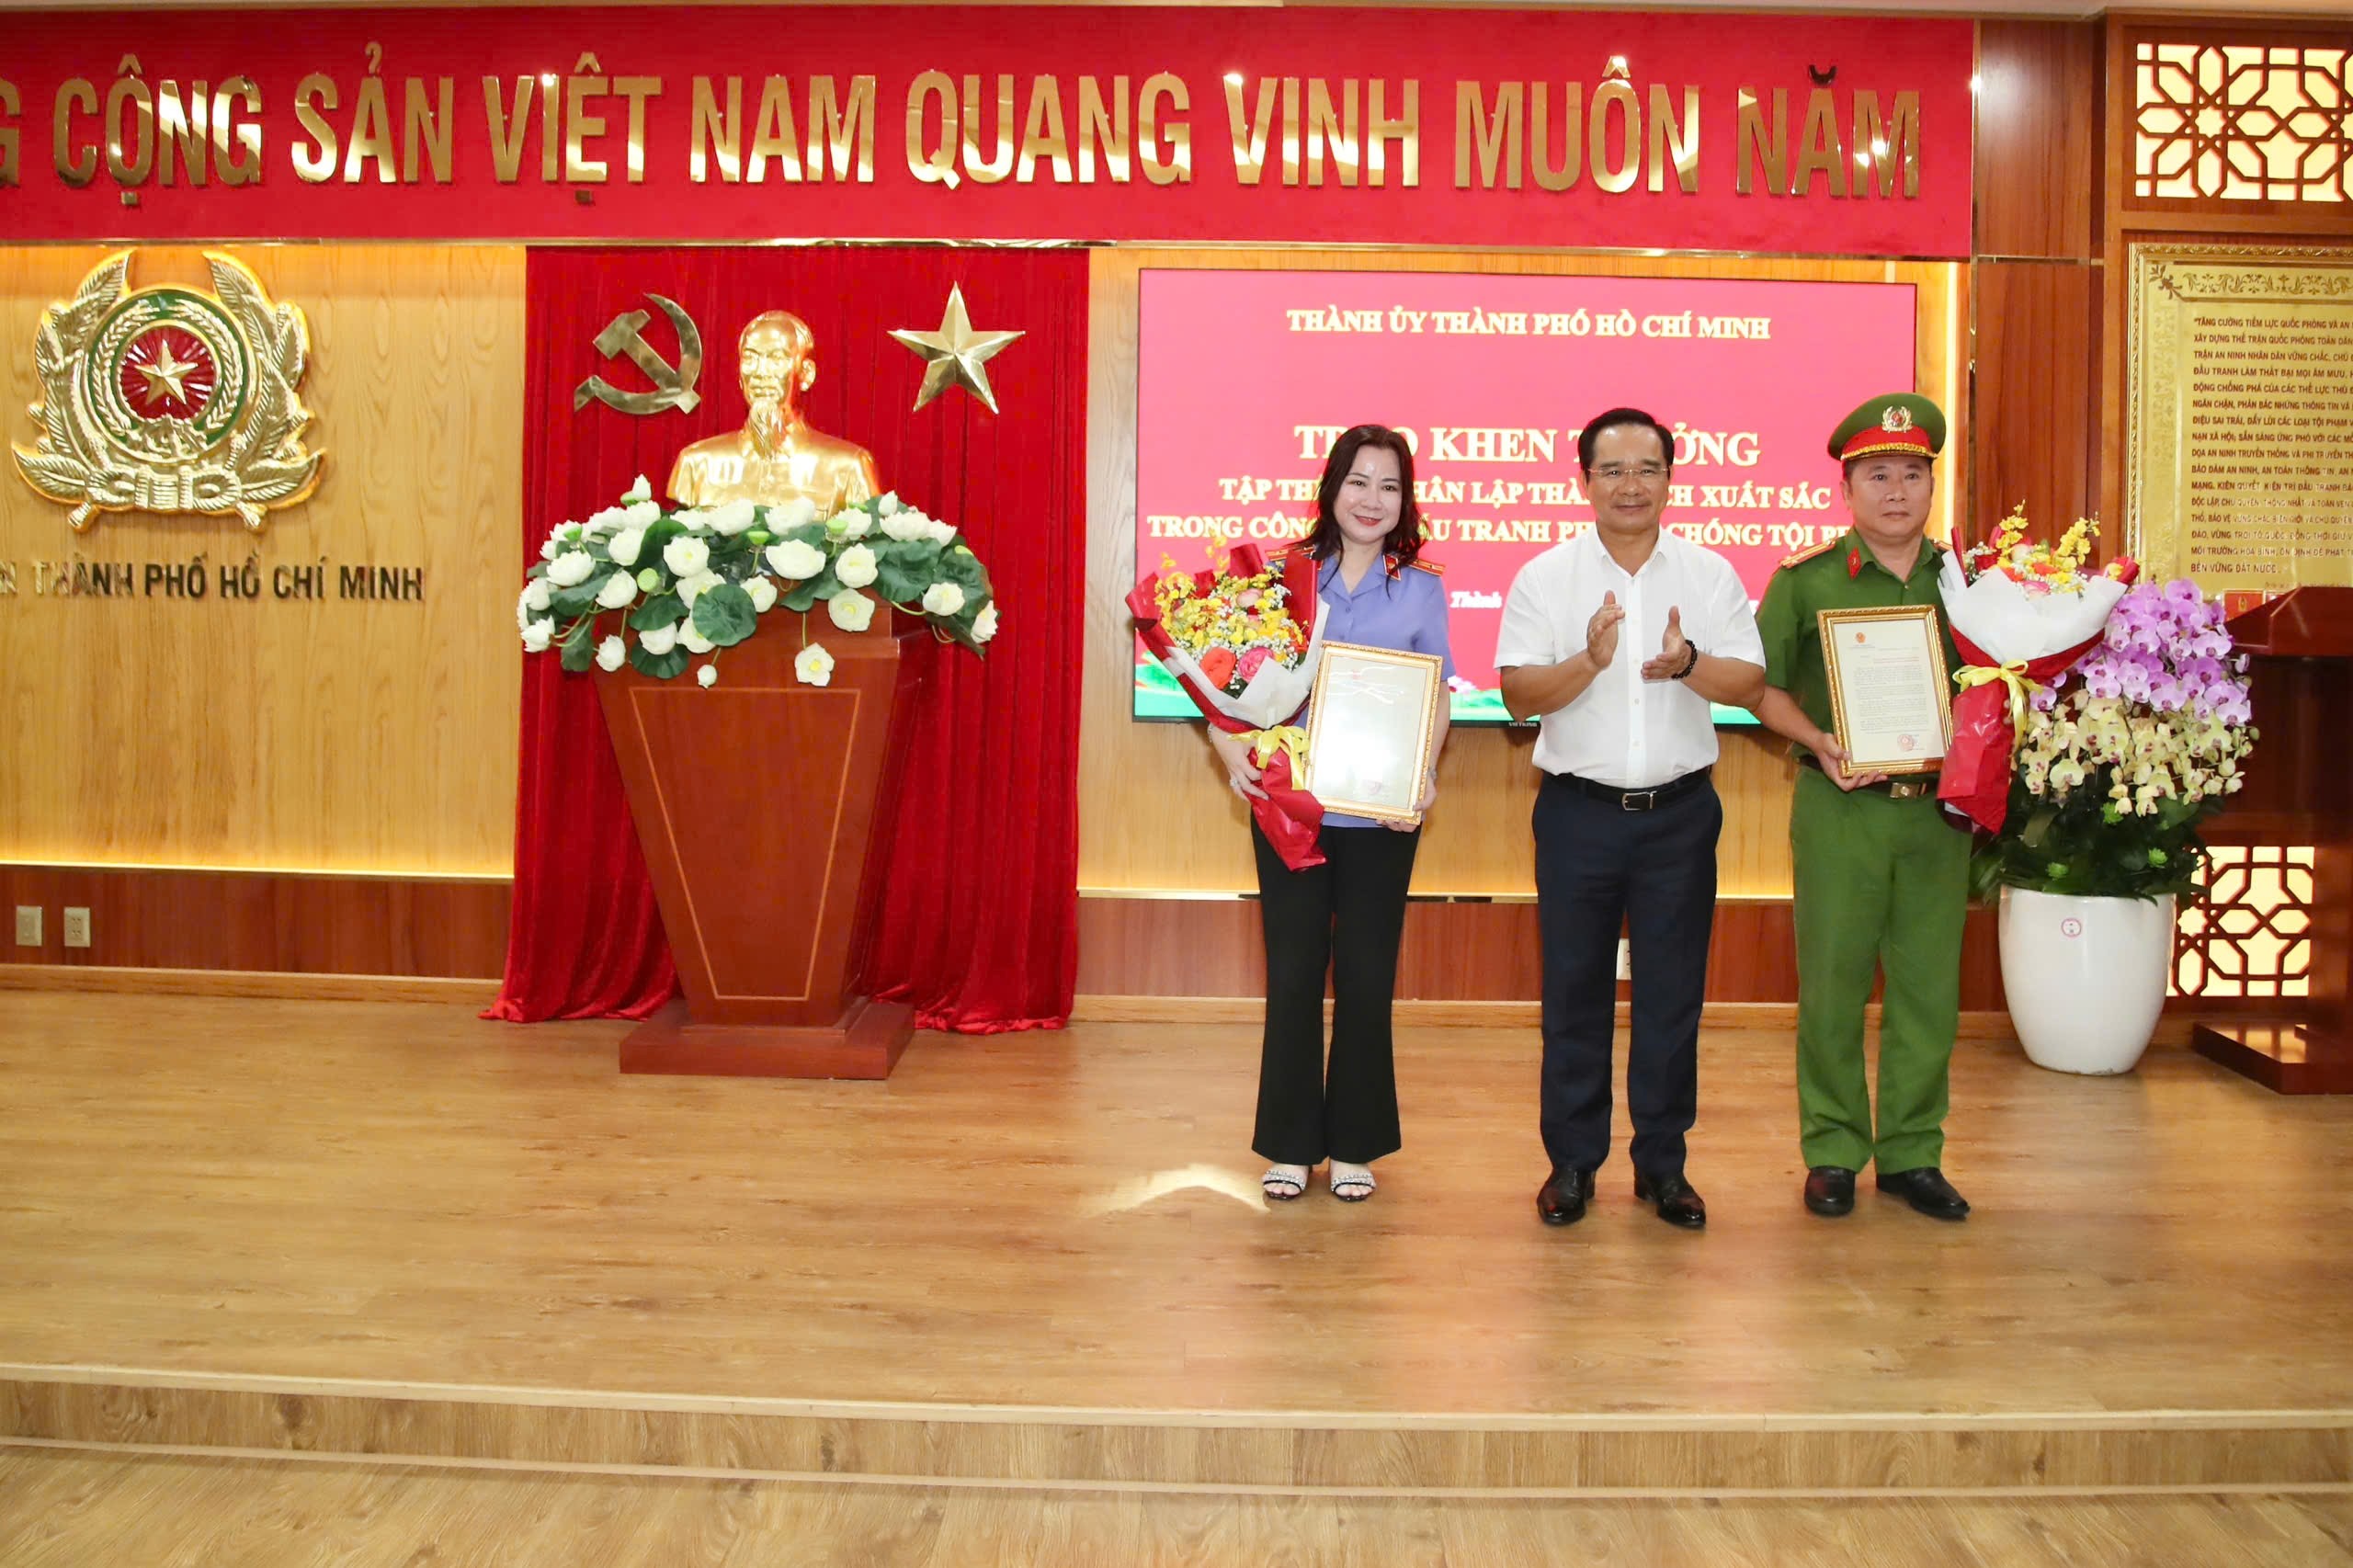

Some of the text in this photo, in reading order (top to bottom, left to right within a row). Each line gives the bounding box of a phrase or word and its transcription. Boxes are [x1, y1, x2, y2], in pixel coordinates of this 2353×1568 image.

[53, 52, 262, 206] CỘNG
[290, 41, 454, 185] SẢN
[483, 51, 662, 205] VIỆT
[689, 74, 876, 184] NAM
[905, 70, 1190, 190] QUANG
[1222, 74, 1419, 187] VINH
[1455, 54, 1699, 193] MUÔN
[1736, 64, 1920, 199] NĂM
[1287, 305, 1771, 339] THÀNH ỦY THÀNH PHỐ HỒ CHÍ MINH
[2340, 321, 2349, 329] AN
[1429, 427, 1559, 462] KHEN
[1219, 475, 1273, 505] TẬP
[1412, 476, 1465, 503] HÂN
[1471, 479, 1523, 508] LẬP
[1700, 481, 1774, 508] XUẤT
[1779, 481, 1831, 509] SẮC
[1147, 515, 1243, 539] TRONG
[1457, 520, 1551, 542] TRANH
[1767, 521, 1817, 551] TỘI
[31, 551, 135, 597] THÀNH
[144, 551, 209, 599] PHỐ
[220, 549, 261, 599] HỒ
[273, 555, 330, 600] CHÍ
[339, 564, 424, 601] MINH
